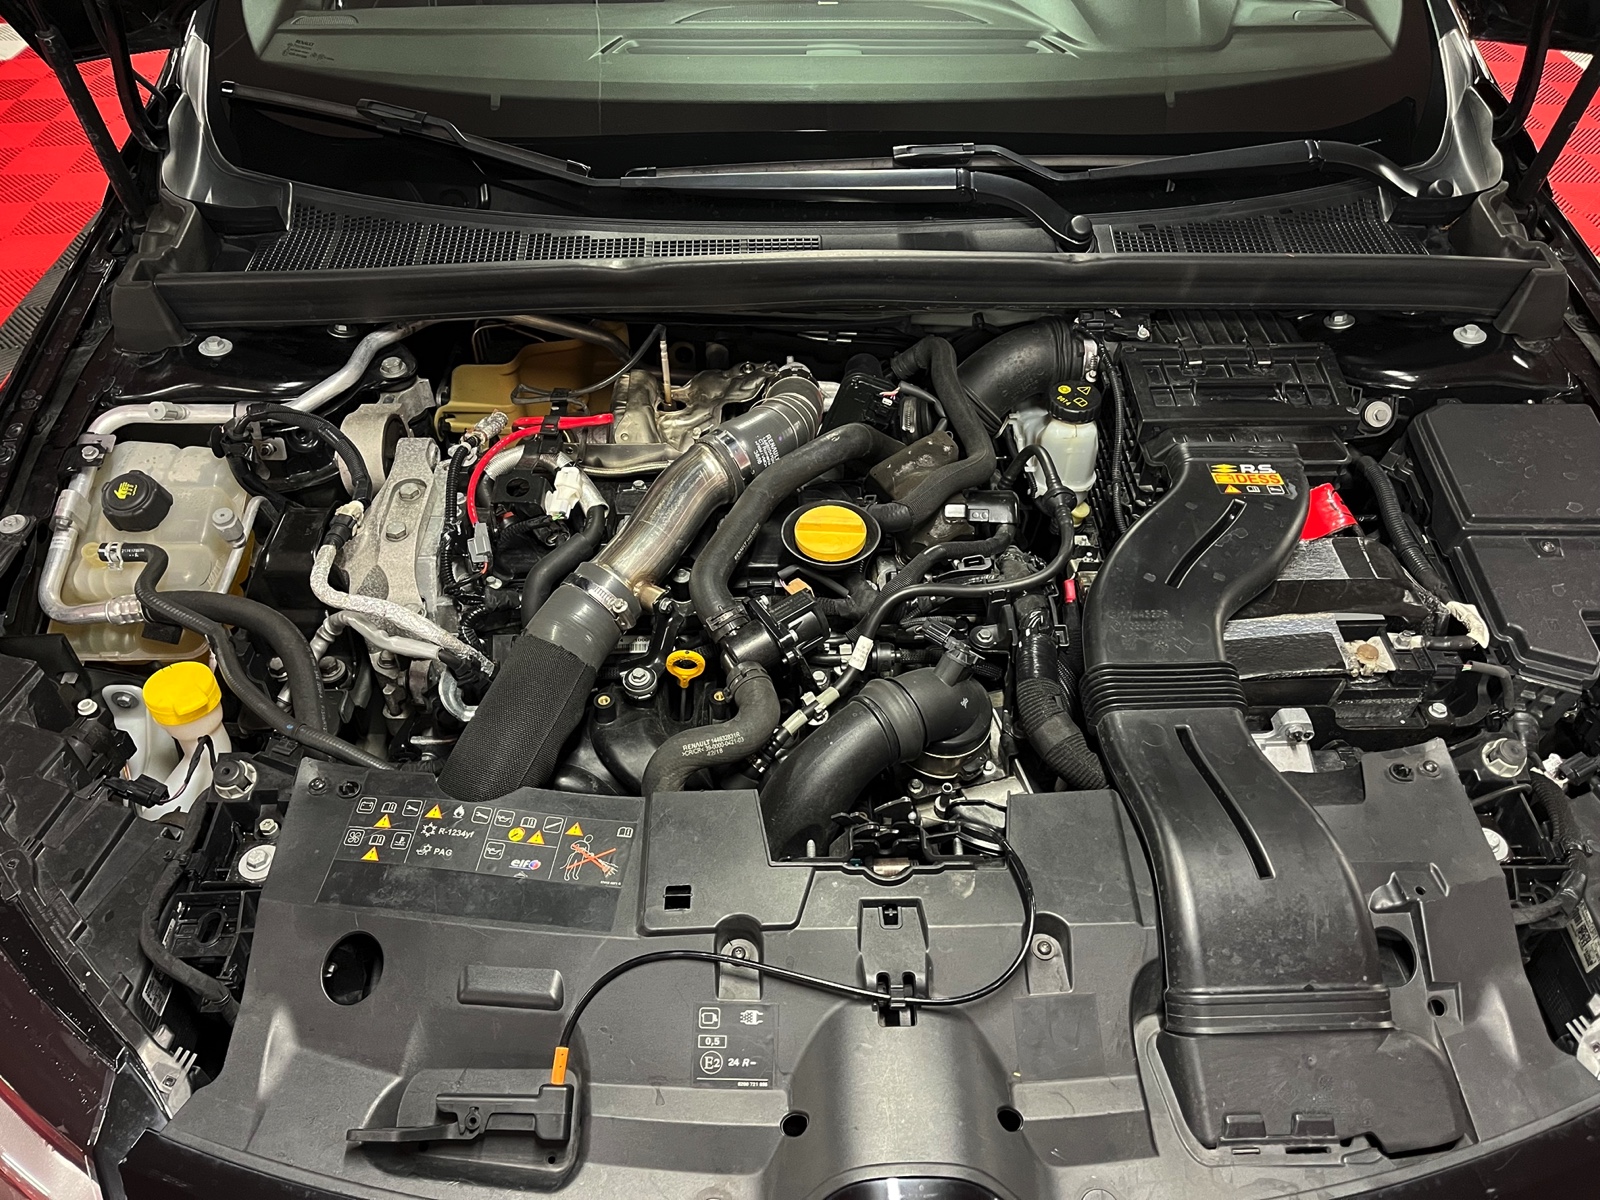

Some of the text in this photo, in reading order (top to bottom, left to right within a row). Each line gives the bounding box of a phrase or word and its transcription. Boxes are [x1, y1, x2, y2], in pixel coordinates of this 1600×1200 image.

[765, 433, 780, 461] RENAULT
[1239, 464, 1276, 474] R.S.
[1236, 474, 1281, 484] DESS
[682, 739, 711, 751] RENAULT
[438, 827, 475, 839] R-1234yf
[433, 848, 453, 857] PAG
[510, 859, 530, 868] elf
[705, 1037, 720, 1047] 0,5
[704, 1056, 720, 1070] E2
[728, 1058, 740, 1067] 24
